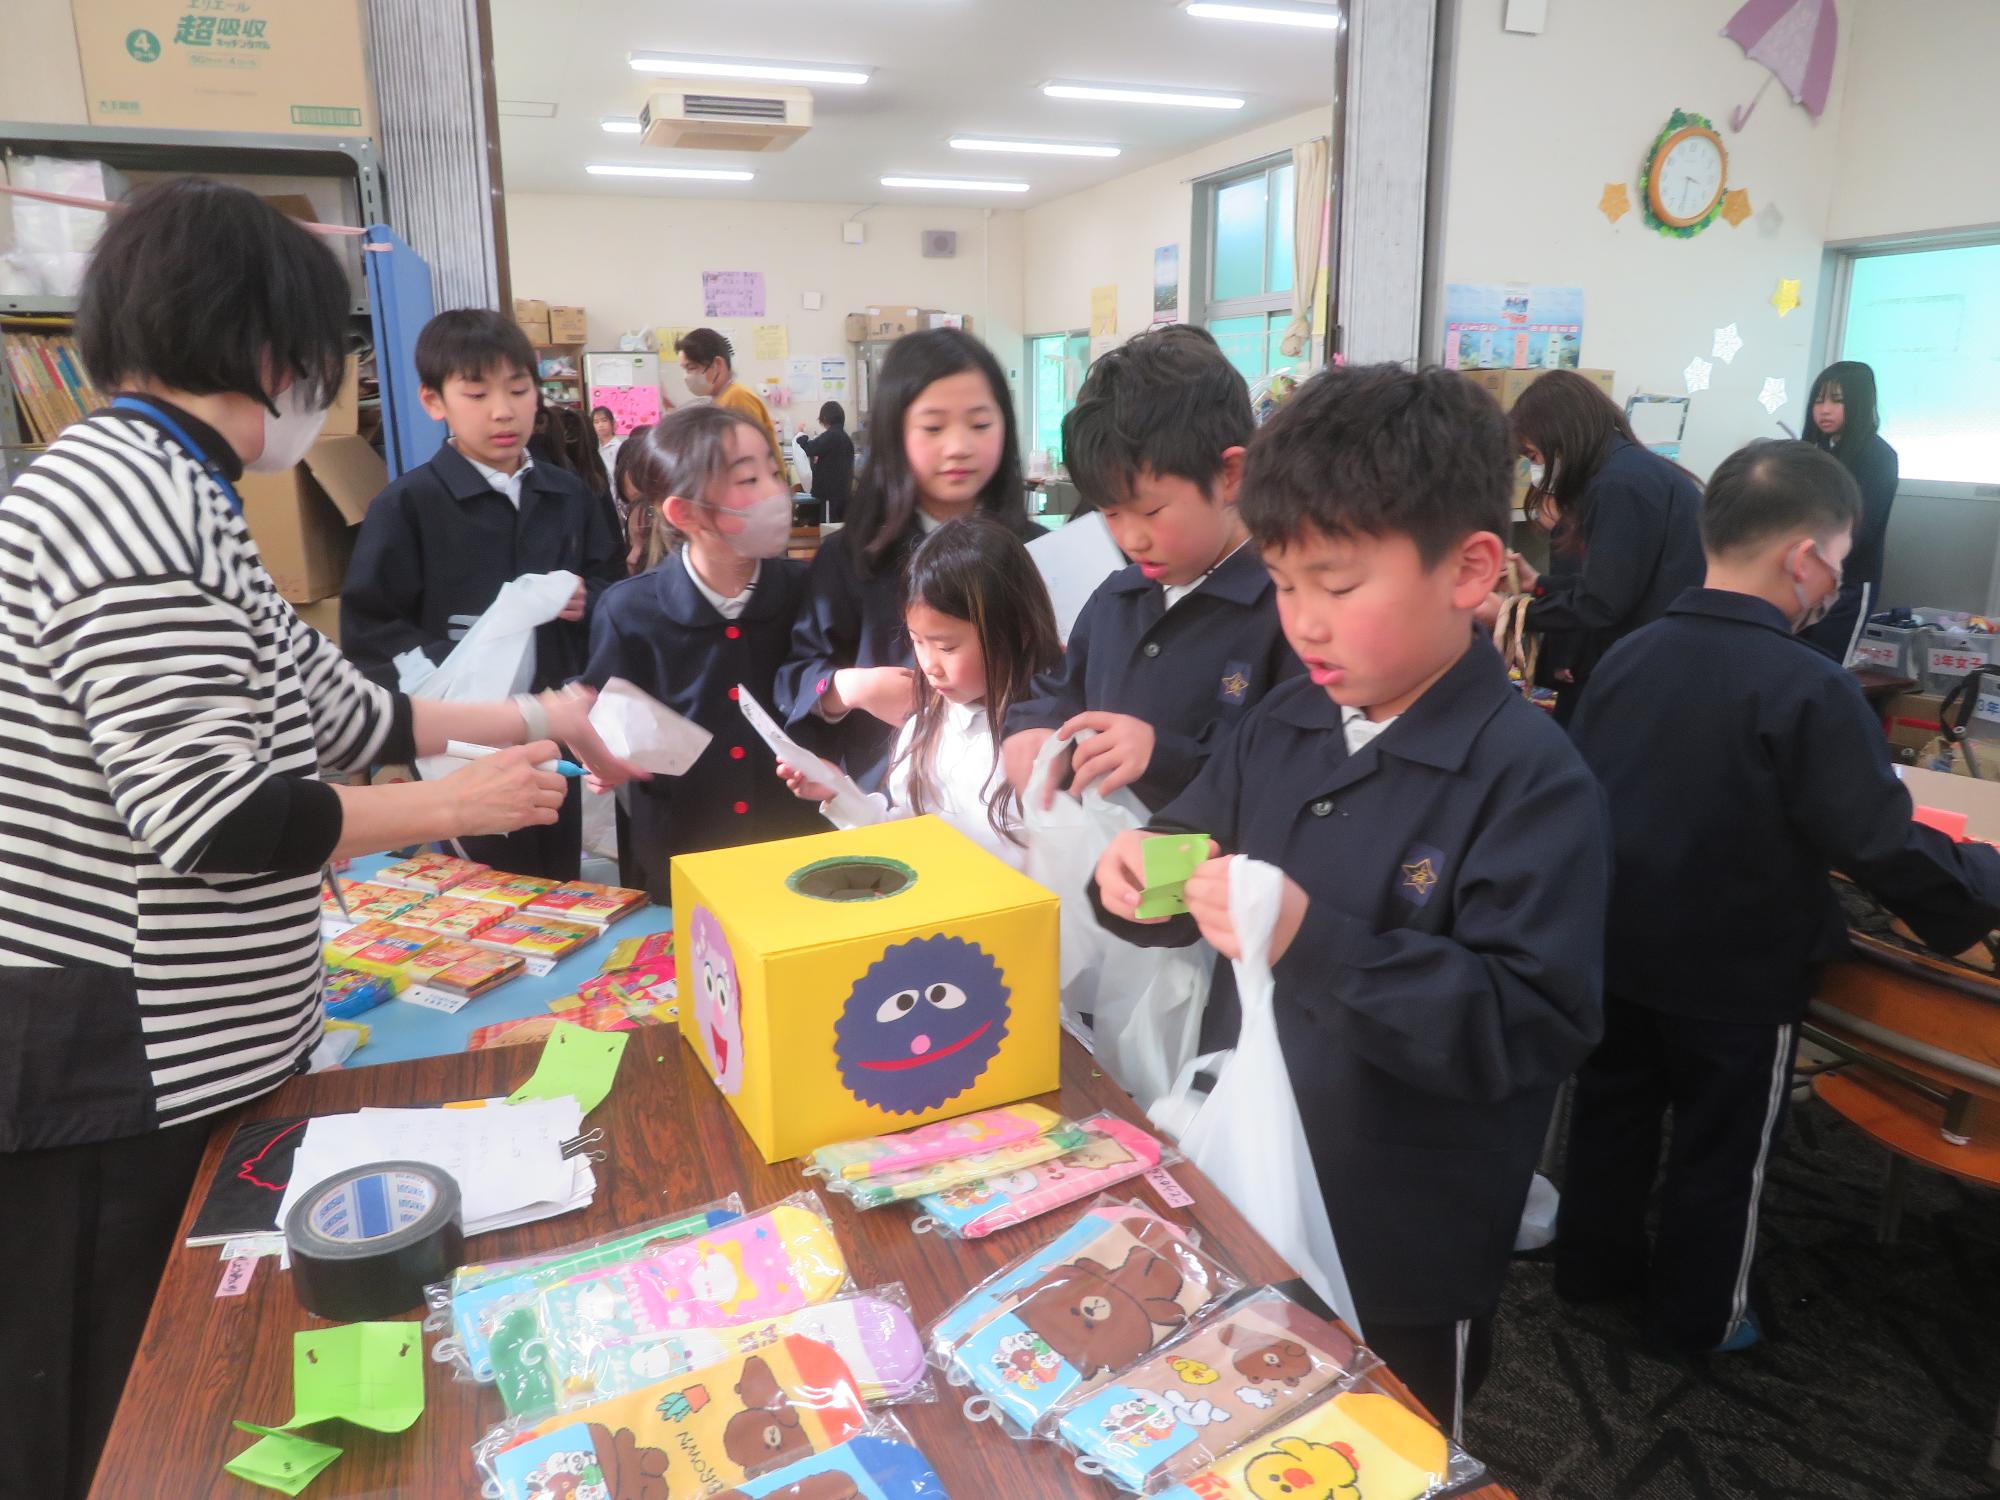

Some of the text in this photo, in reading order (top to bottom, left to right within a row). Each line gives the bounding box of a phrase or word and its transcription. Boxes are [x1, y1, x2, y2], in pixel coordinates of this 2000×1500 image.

[133, 32, 151, 53] 4
[173, 14, 269, 46] 超吸収
[675, 1431, 724, 1495] BROWN
